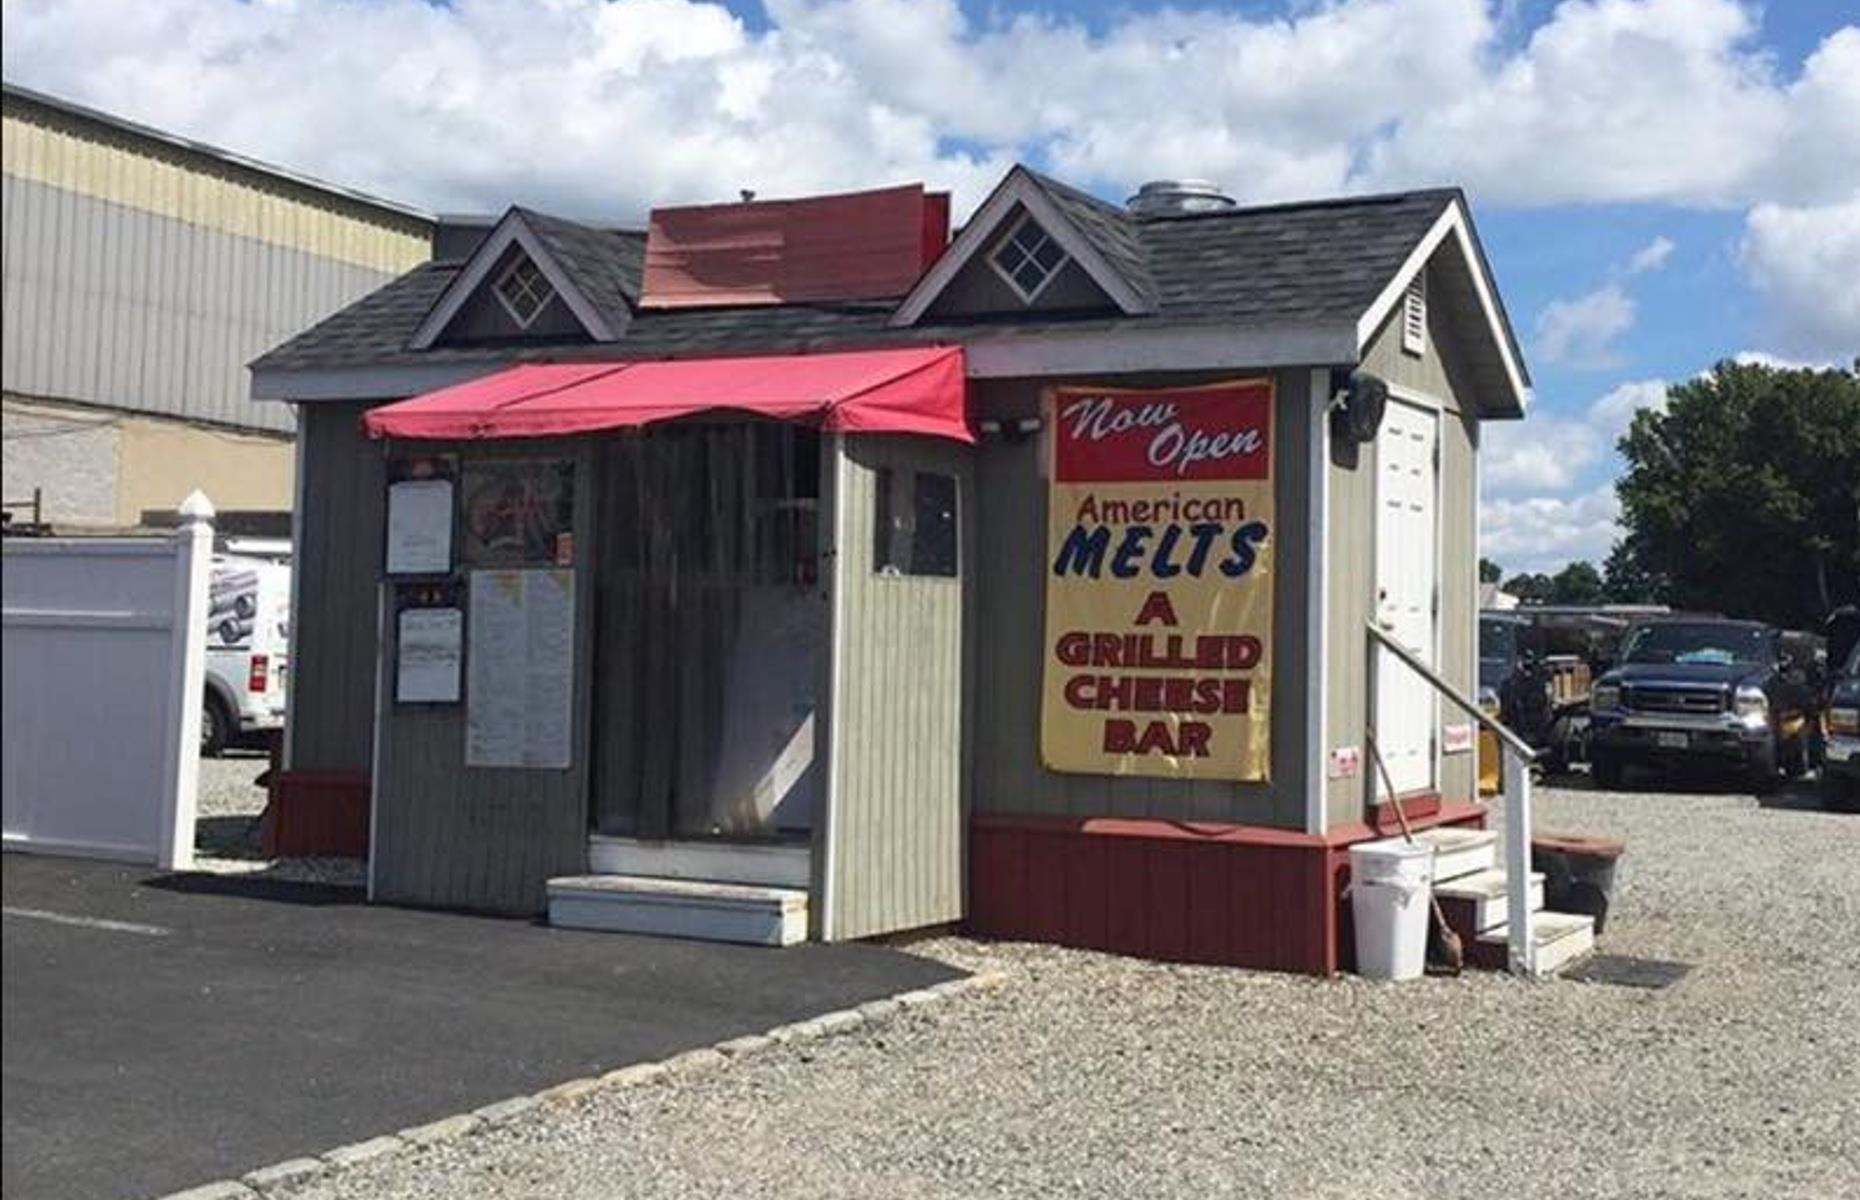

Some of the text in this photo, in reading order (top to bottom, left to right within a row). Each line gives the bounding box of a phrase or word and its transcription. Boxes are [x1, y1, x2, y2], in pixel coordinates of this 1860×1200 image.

[1062, 397, 1178, 440] Now
[1148, 423, 1262, 475] Open
[1076, 492, 1245, 523] American
[1053, 521, 1269, 579] MELTS
[1134, 591, 1178, 626] A
[1055, 631, 1263, 669] GRILLED
[1064, 674, 1252, 714] CHEESE
[1103, 719, 1213, 757] BAR
